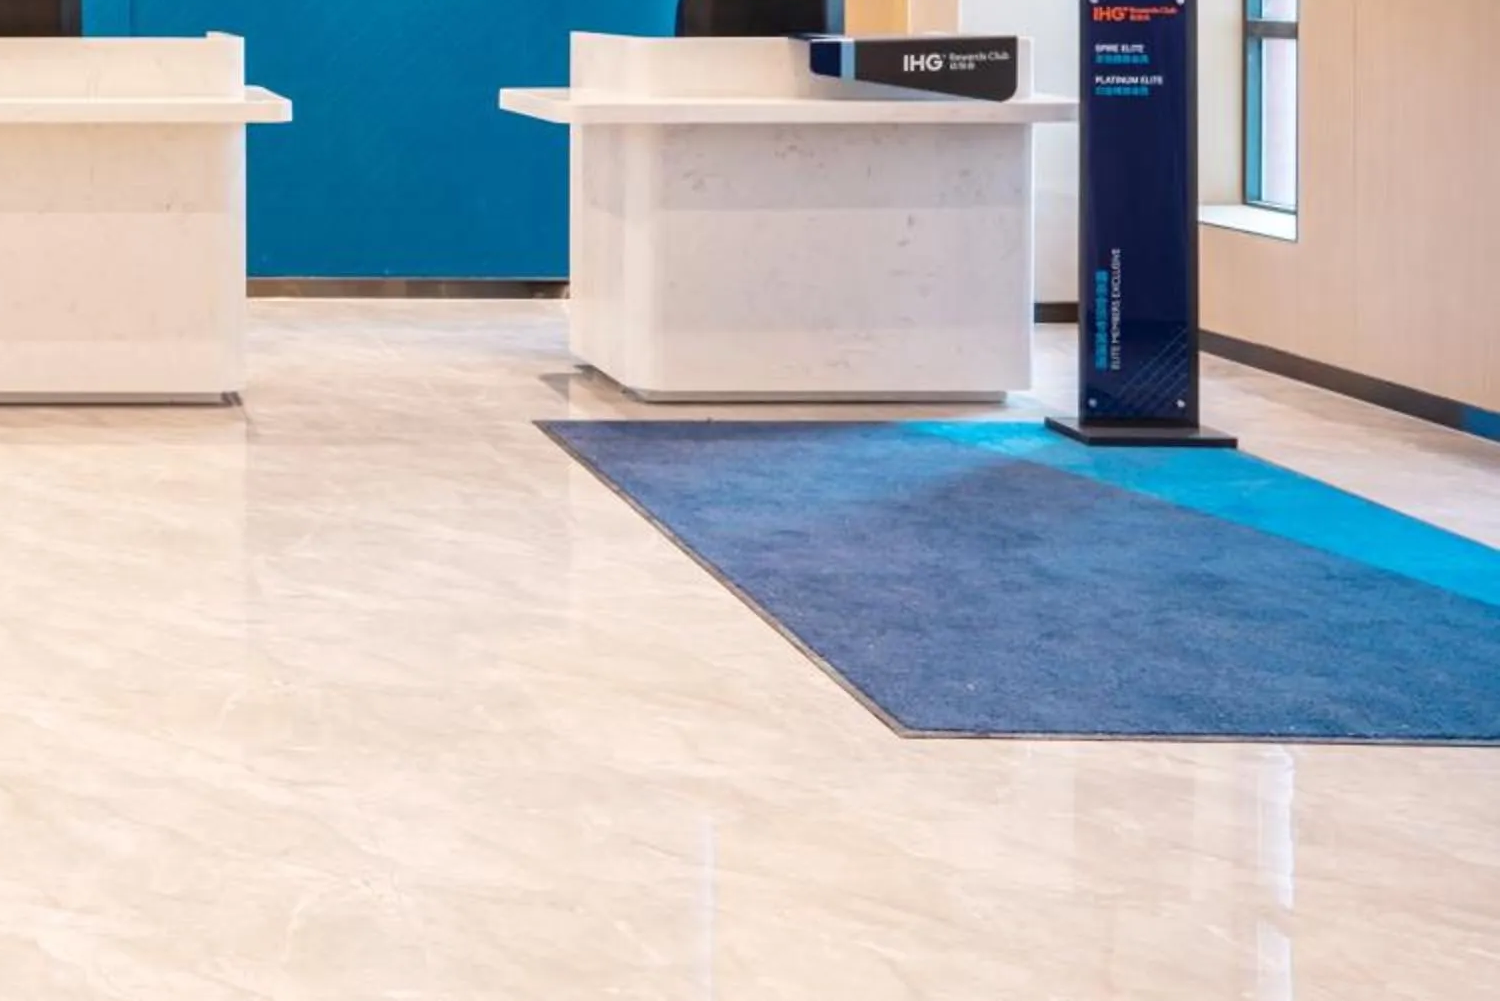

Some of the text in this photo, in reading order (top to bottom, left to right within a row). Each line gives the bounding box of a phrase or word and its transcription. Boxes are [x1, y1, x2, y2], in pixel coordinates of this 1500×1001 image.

[1093, 6, 1125, 21] IHG
[1121, 44, 1144, 53] ELITE
[903, 54, 943, 72] IHG
[949, 52, 986, 61] Rewards
[987, 51, 1009, 60] Club
[1095, 76, 1163, 85] PLATINUM ELITE
